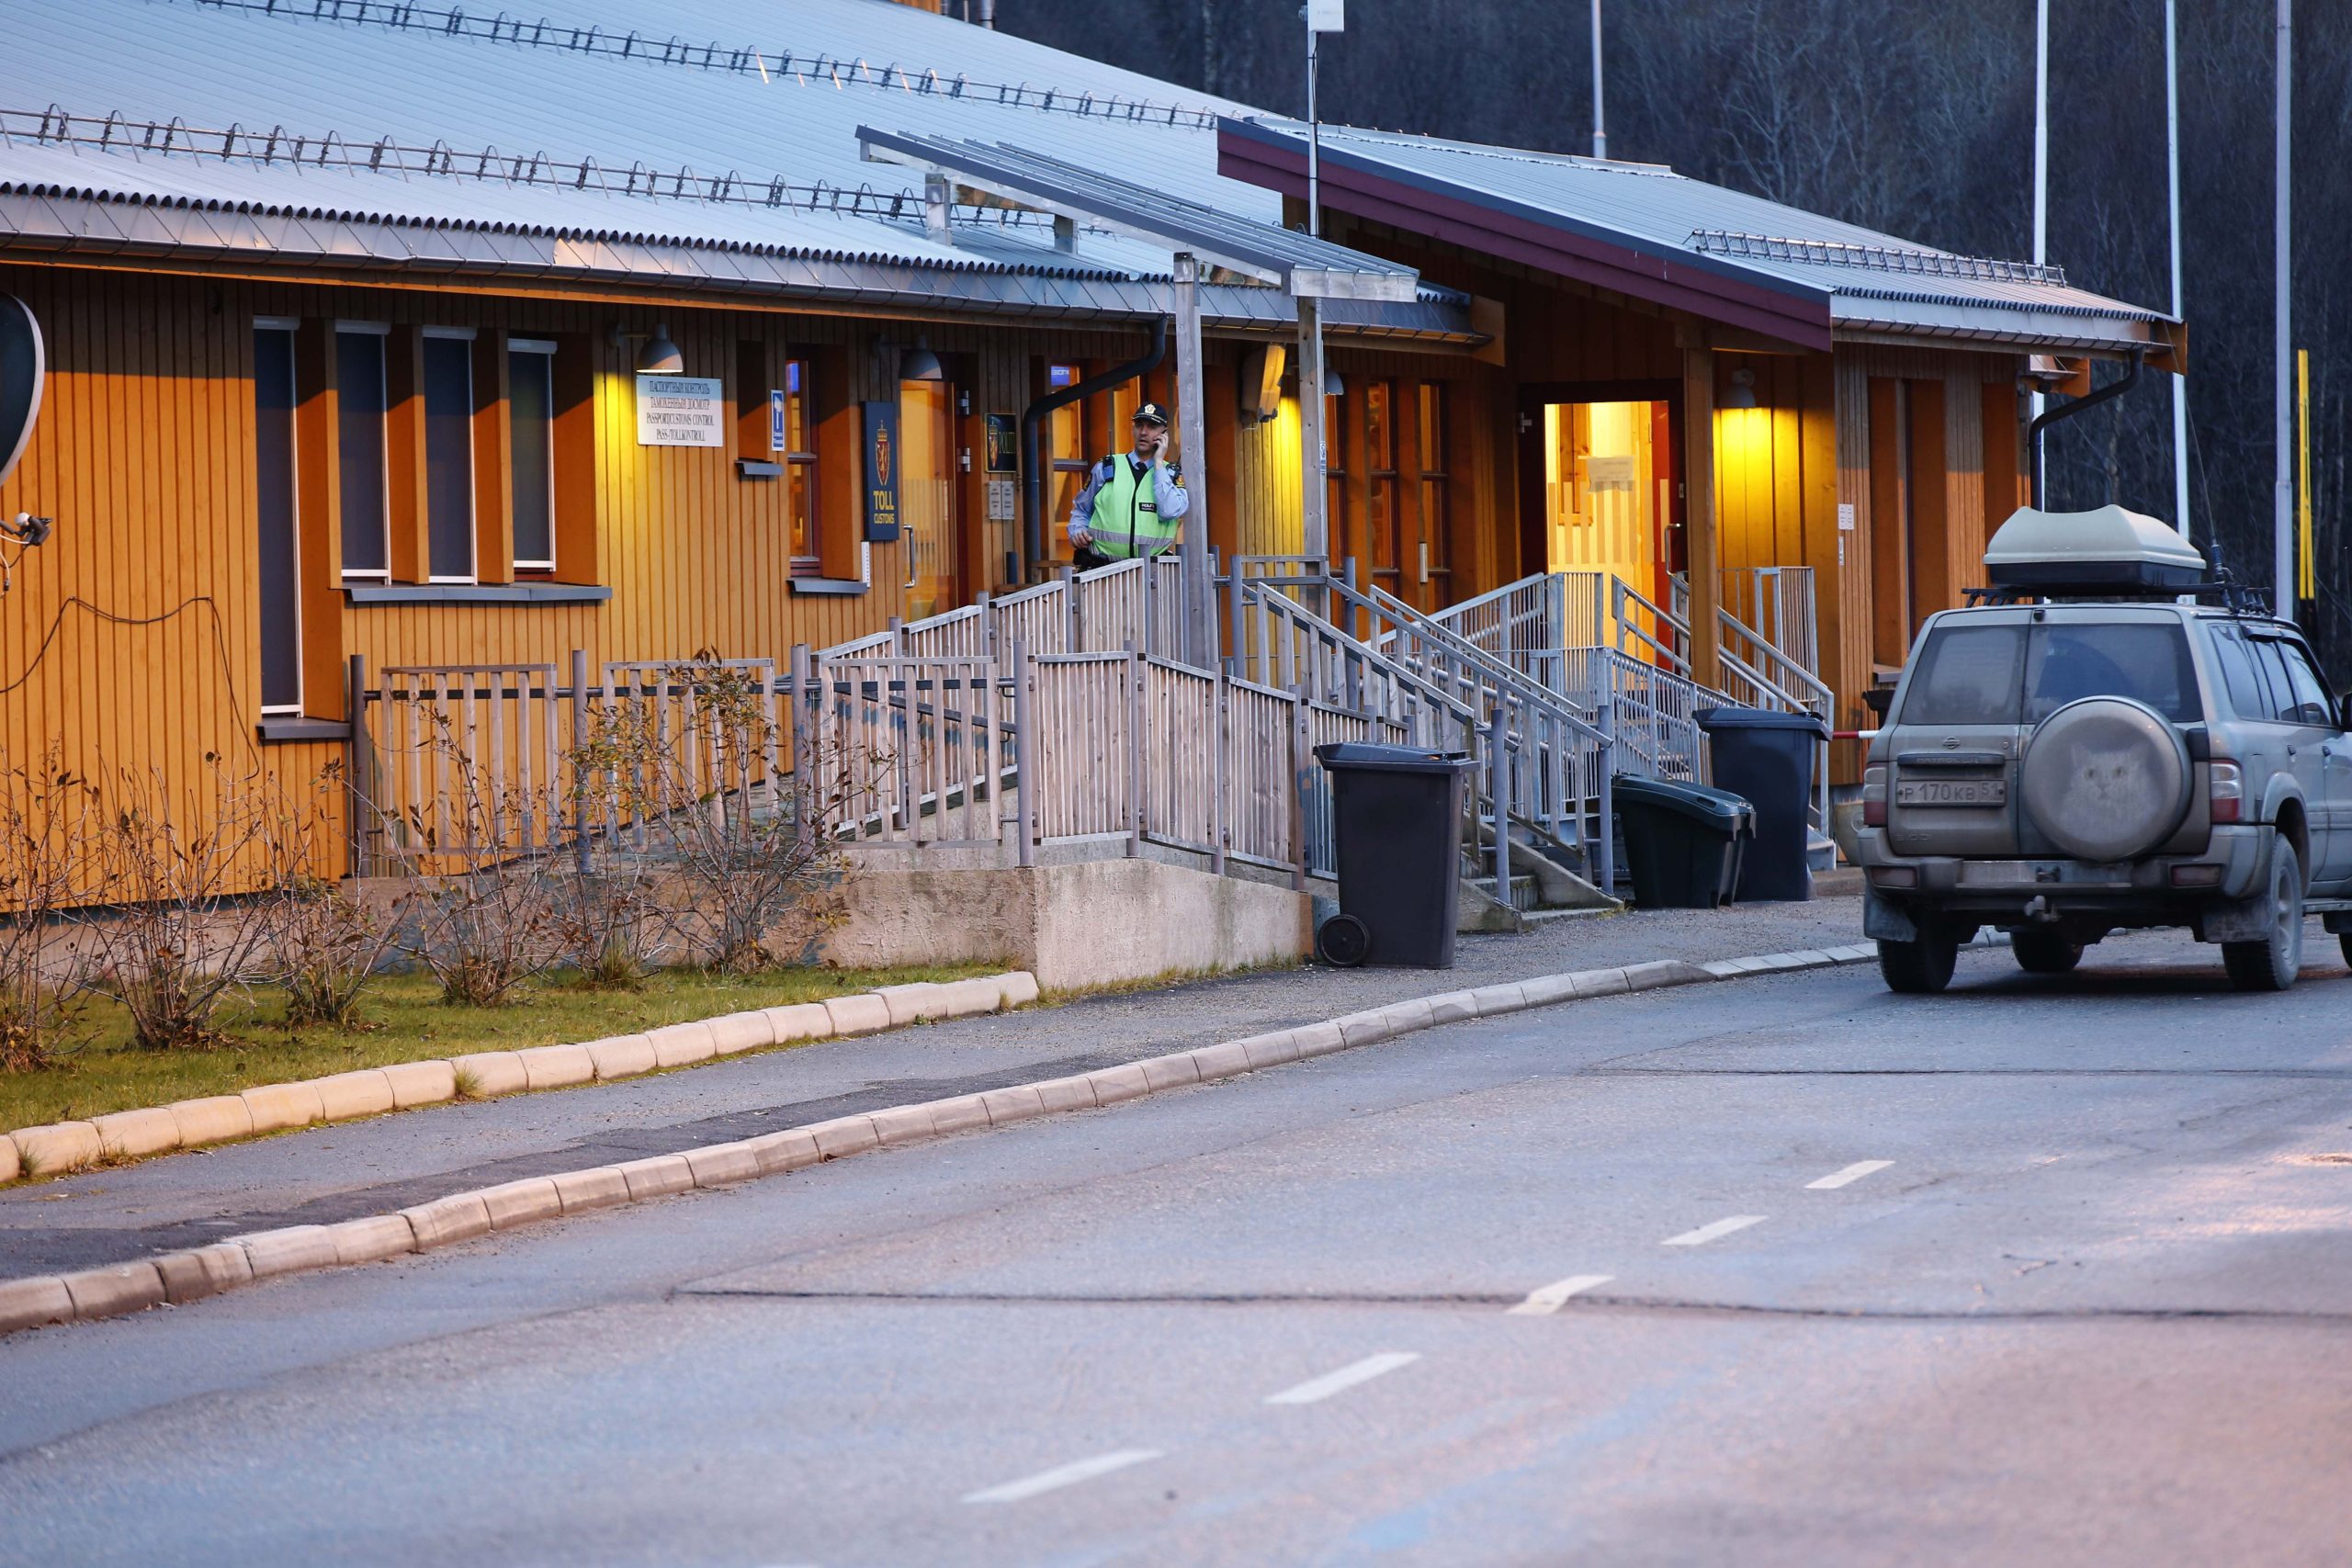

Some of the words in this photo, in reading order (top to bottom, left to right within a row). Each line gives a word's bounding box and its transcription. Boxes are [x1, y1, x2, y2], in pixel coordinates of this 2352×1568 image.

[693, 413, 715, 426] CONTROL
[873, 490, 895, 511] TOLL
[874, 513, 895, 525] CUSTOMS
